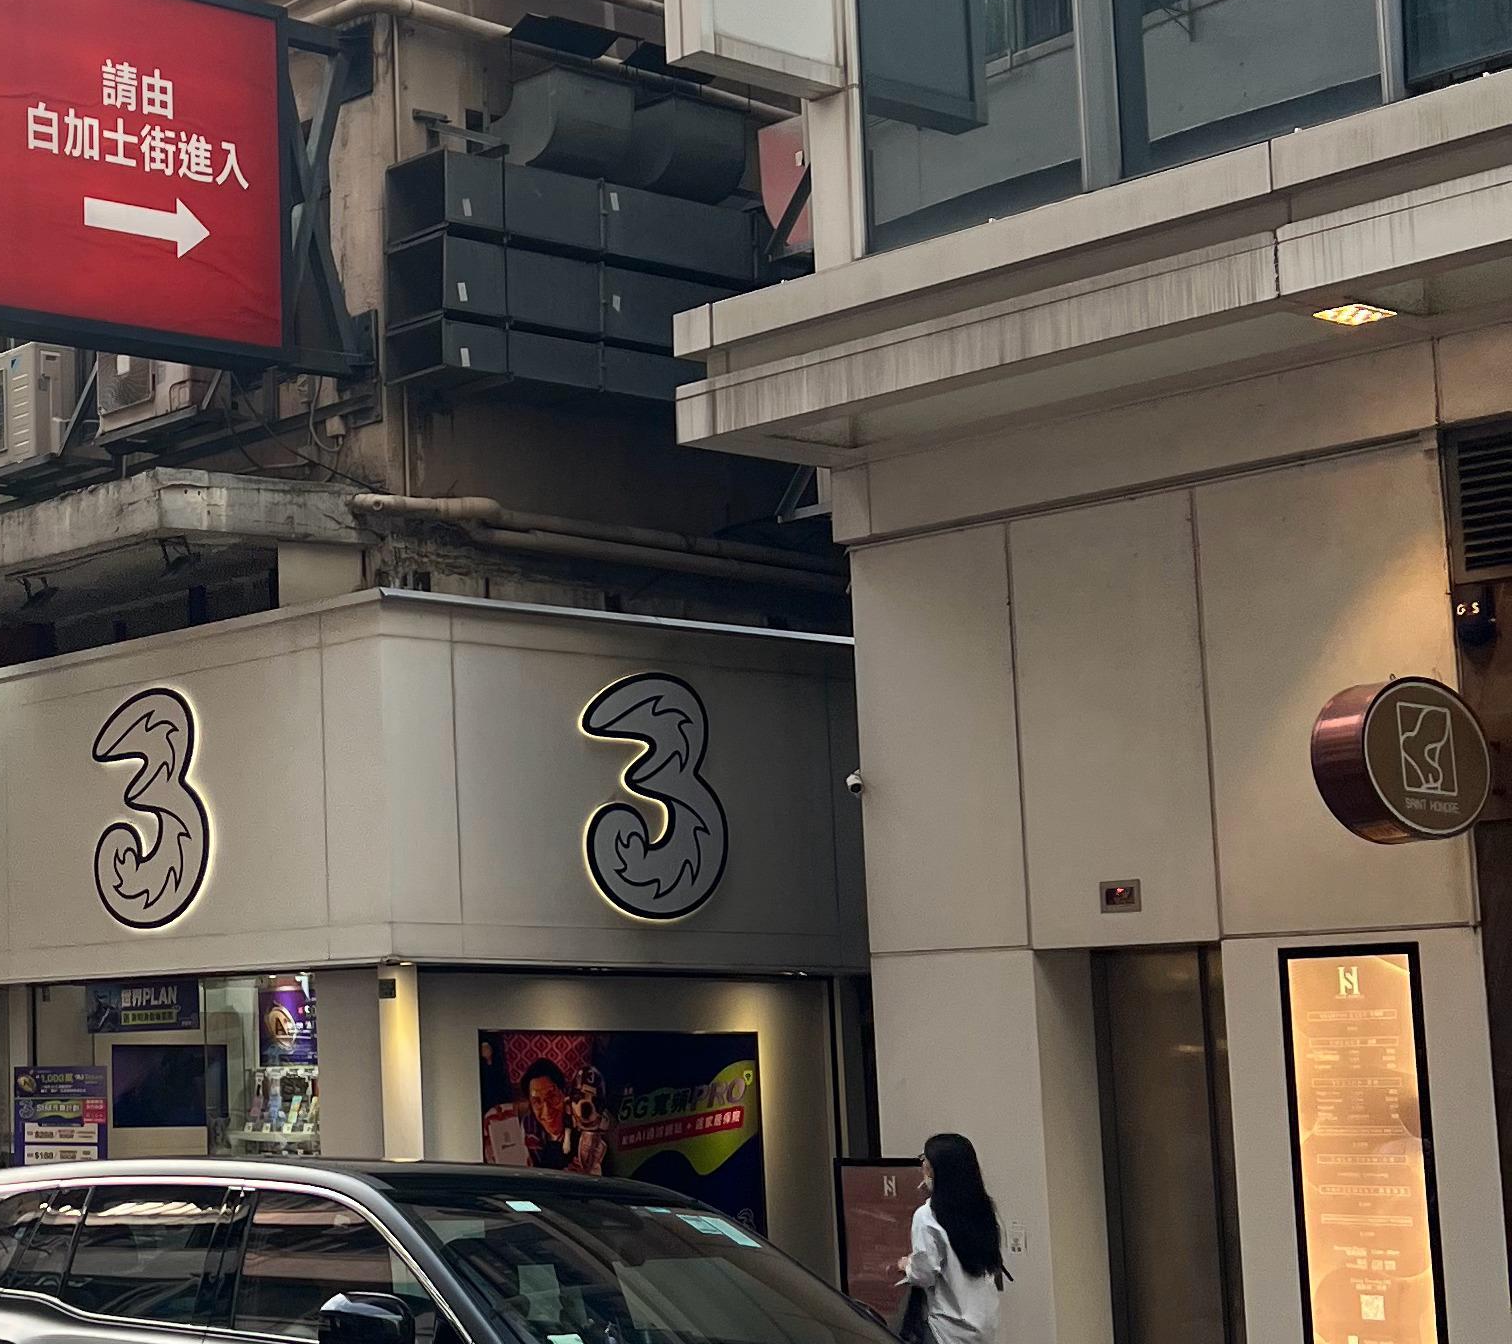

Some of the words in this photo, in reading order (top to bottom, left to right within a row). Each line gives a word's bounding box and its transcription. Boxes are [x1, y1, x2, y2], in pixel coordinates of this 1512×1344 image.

[101, 58, 175, 120] 請由
[26, 102, 250, 191] 白加士街進入
